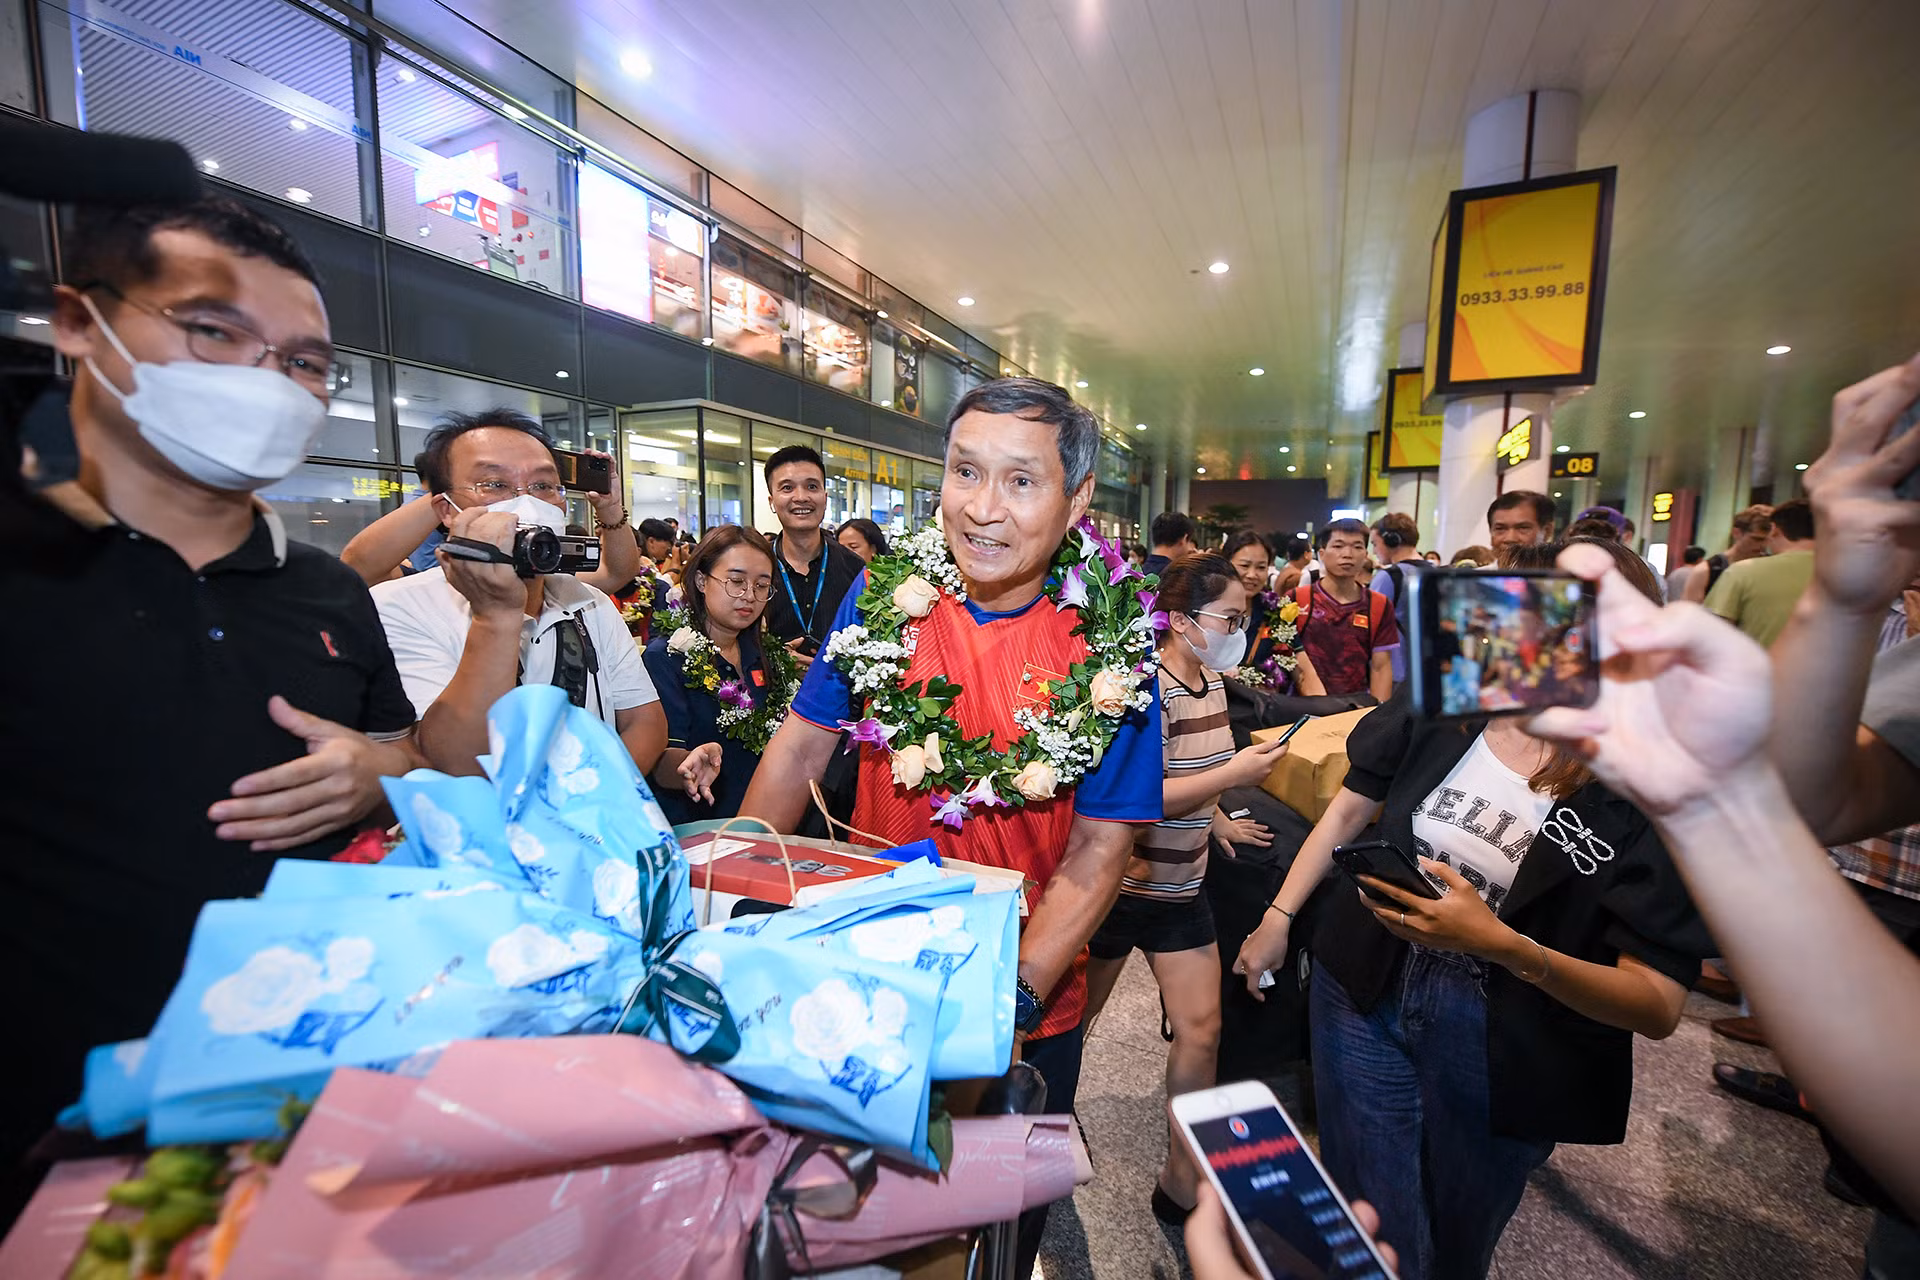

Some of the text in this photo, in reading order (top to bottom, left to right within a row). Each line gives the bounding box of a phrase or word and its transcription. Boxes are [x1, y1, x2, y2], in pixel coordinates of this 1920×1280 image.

[1460, 281, 1585, 306] 0933.33.99.88
[876, 455, 898, 485] A1
[1567, 457, 1593, 474] 08
